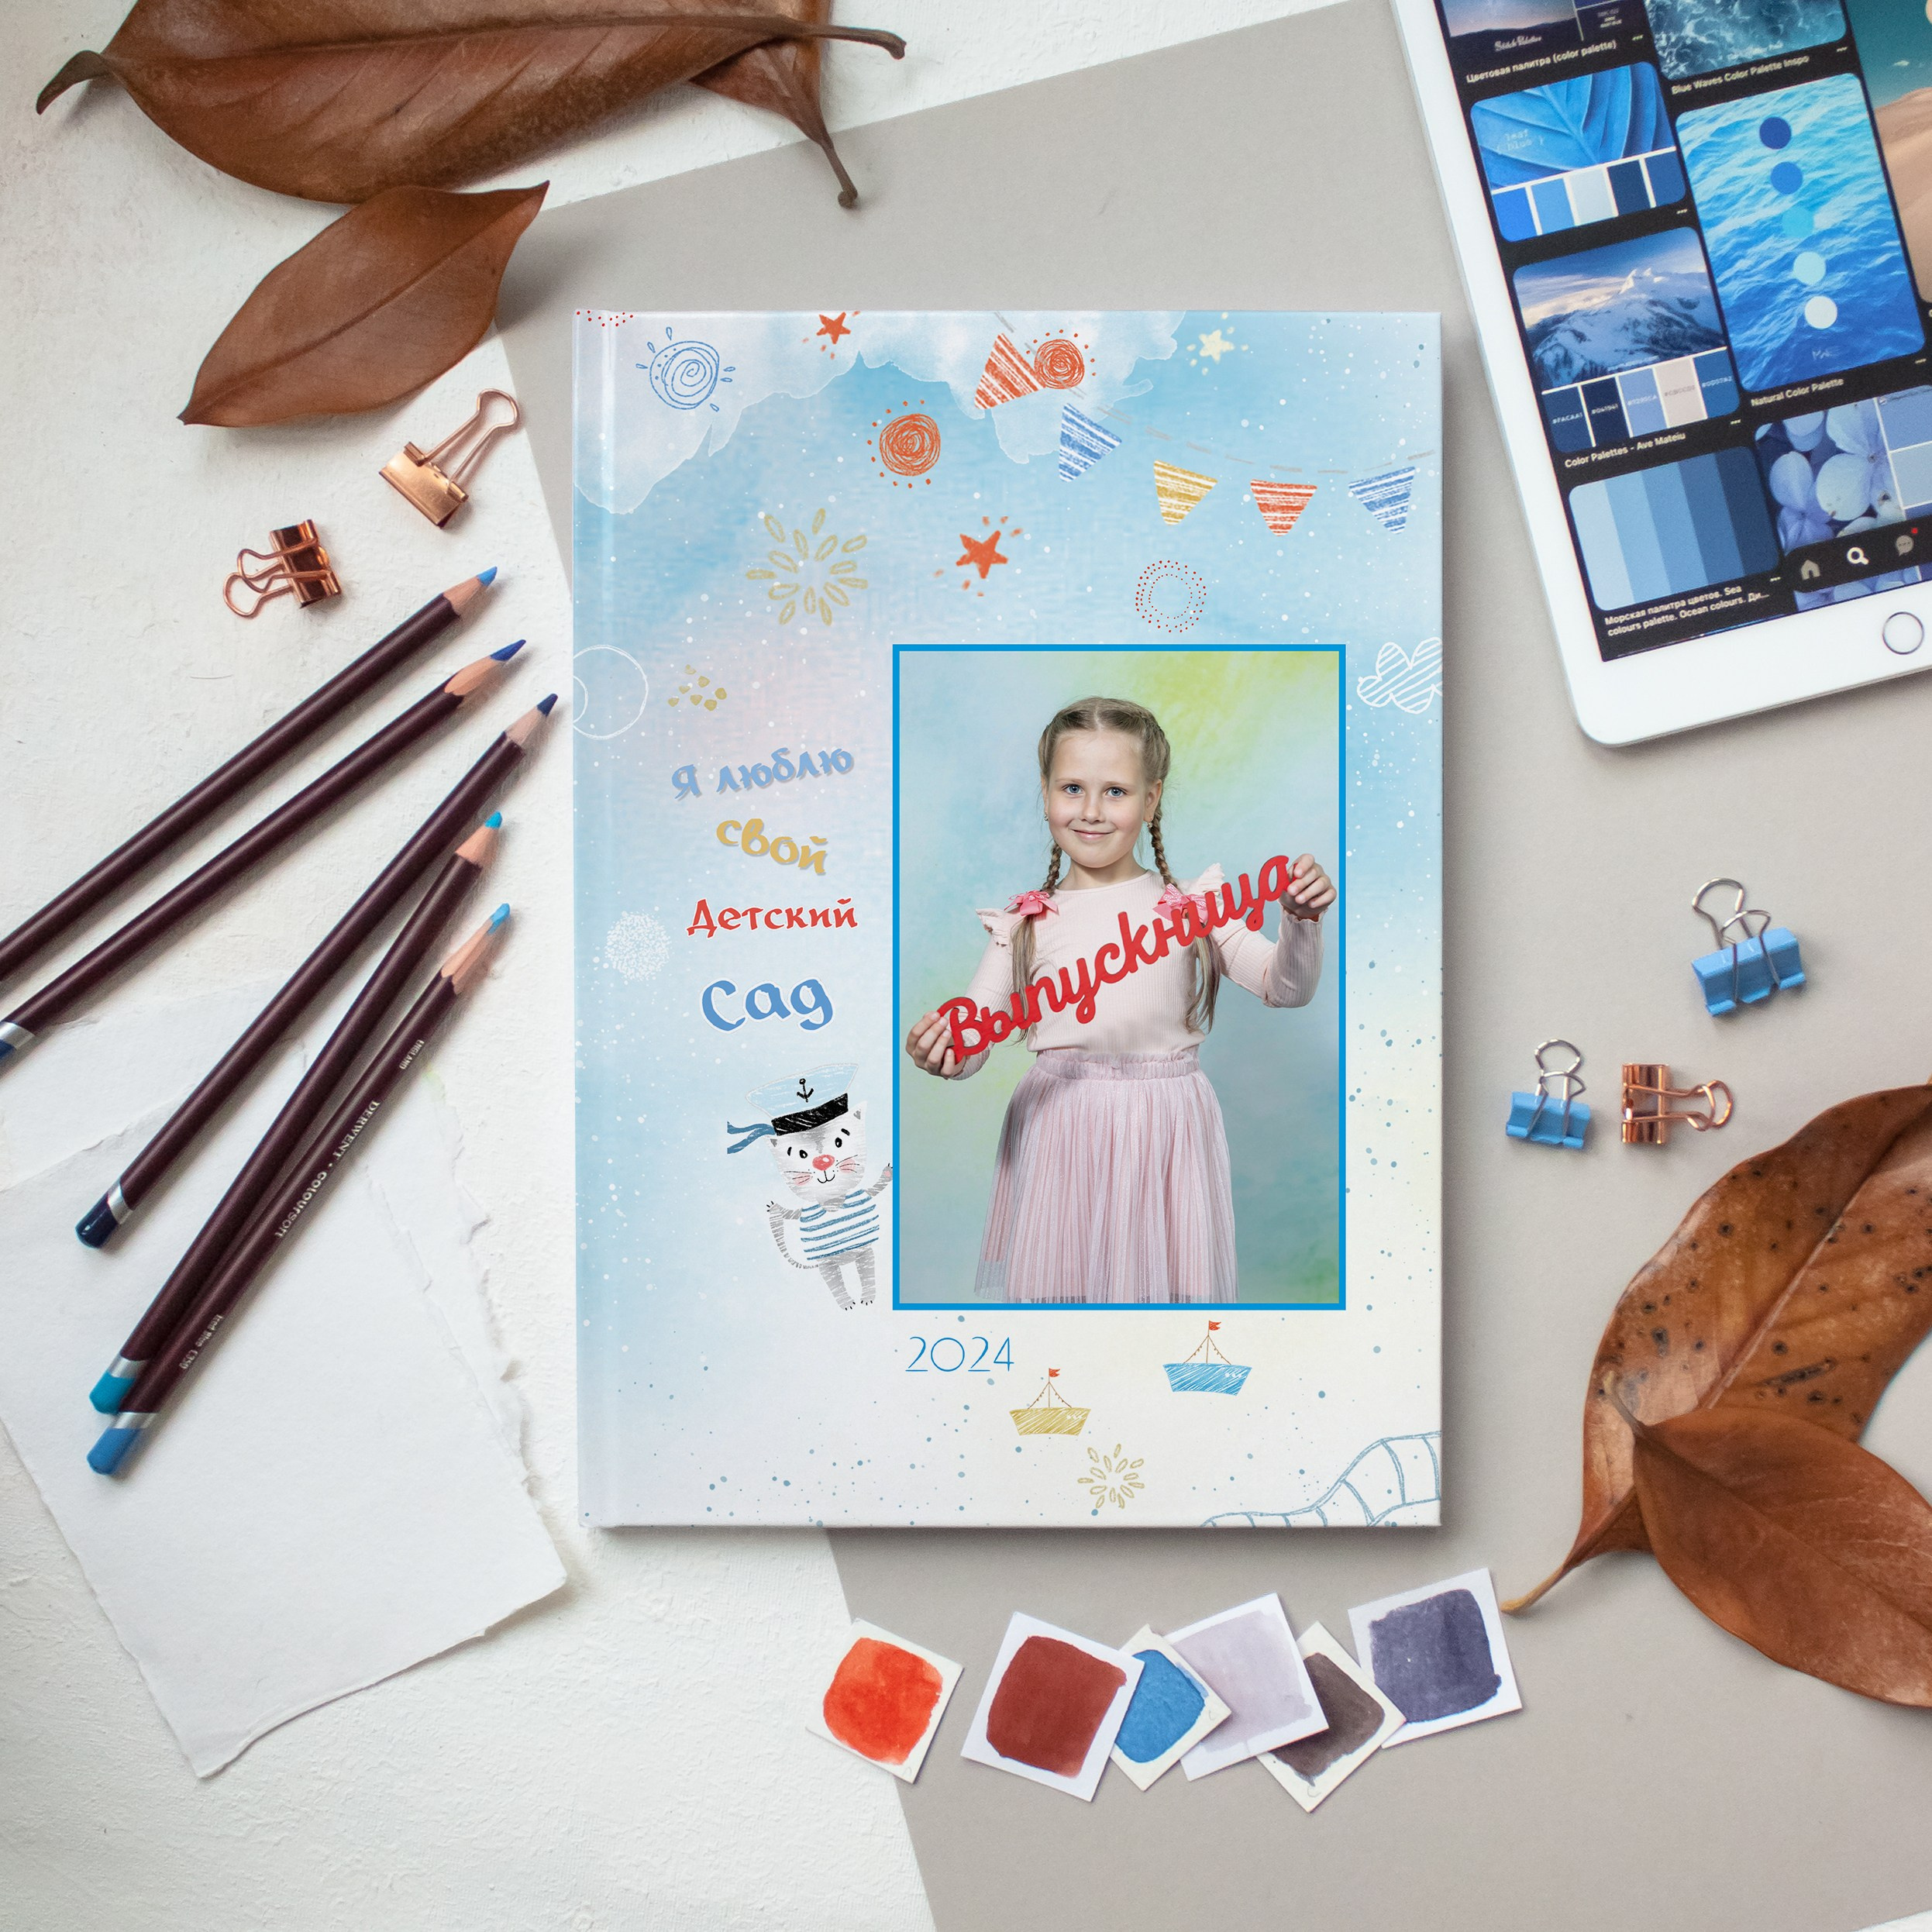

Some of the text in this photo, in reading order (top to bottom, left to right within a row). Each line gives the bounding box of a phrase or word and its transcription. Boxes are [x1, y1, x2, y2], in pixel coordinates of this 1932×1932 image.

[1466, 40, 1617, 83] Цветовая палитра (color palette)
[1671, 55, 1810, 95] Blue Waves Color Palette Inspo
[1751, 377, 1844, 407] Natural Color Palette
[1565, 453, 1589, 468] Color
[1590, 444, 1628, 462] Palettes
[1637, 439, 1653, 451] Ave
[1604, 585, 1743, 626] Морская палитра цветов. Sea
[1608, 623, 1641, 637] colours
[1643, 614, 1678, 629] palette.
[1679, 605, 1709, 619] Ocean
[1710, 598, 1745, 611] colours.
[671, 747, 854, 800] Я люблю
[716, 818, 828, 874] свой
[687, 897, 858, 938] Детский
[936, 855, 1299, 1064] Выпускница
[701, 977, 835, 1033] Сад
[399, 1039, 425, 1070] ENGLAND
[332, 1100, 381, 1159] DERWENT
[195, 1331, 212, 1347] Blue
[905, 1336, 1014, 1372] 2024
